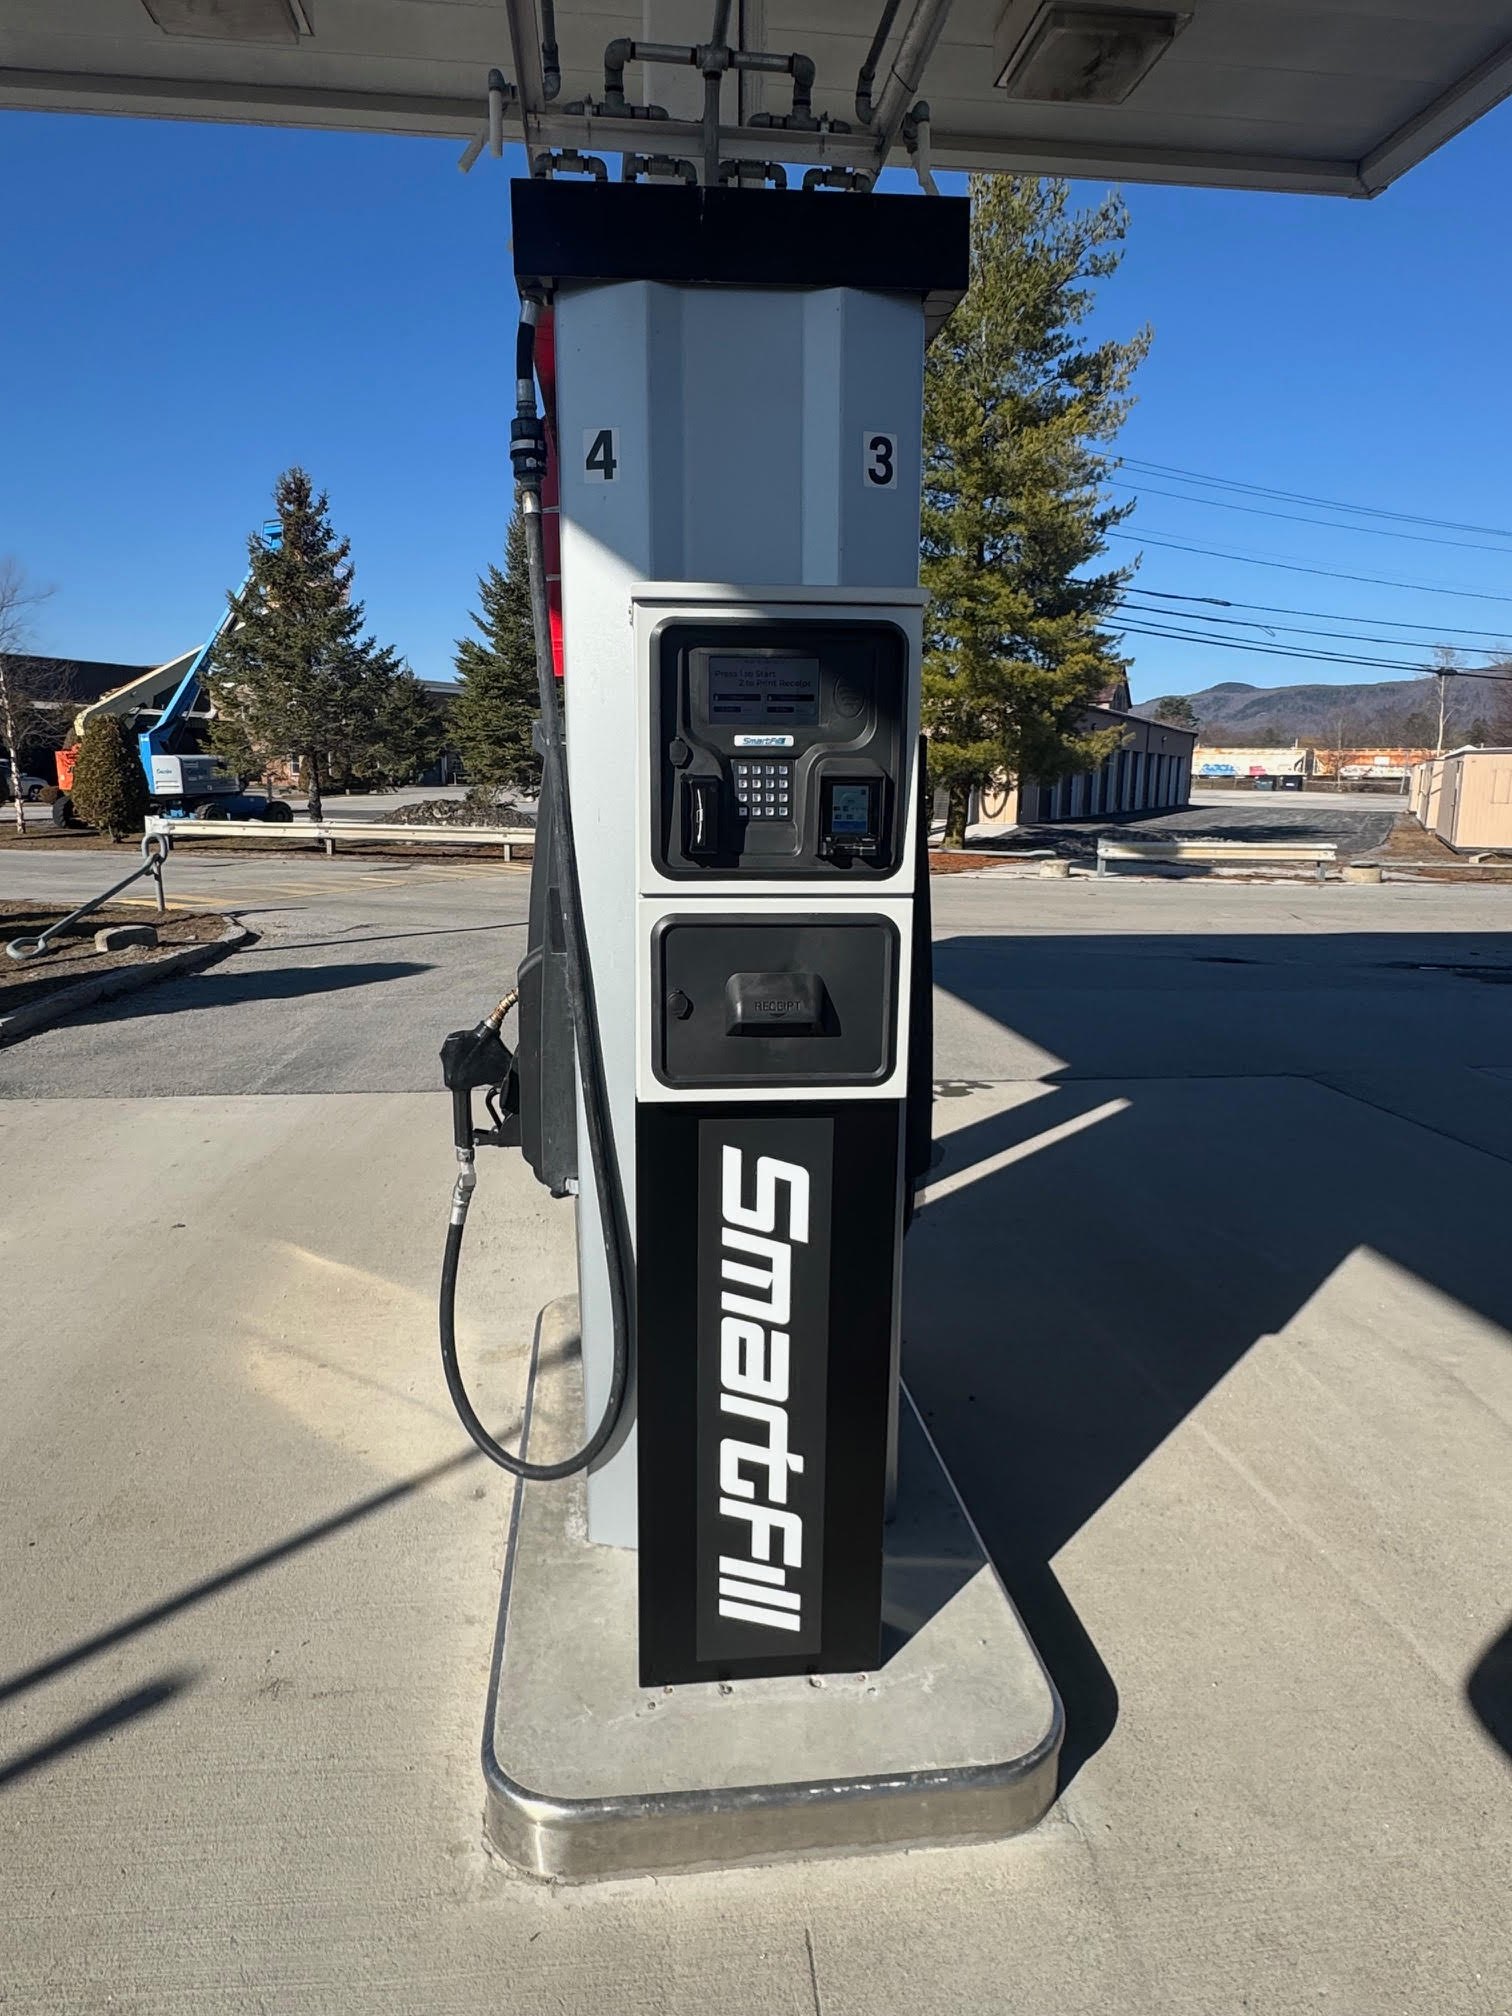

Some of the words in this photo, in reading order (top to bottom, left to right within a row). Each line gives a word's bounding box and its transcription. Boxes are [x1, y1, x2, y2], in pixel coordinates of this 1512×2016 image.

[585, 429, 617, 480] 4
[867, 435, 894, 485] 3
[714, 670, 738, 678] Press
[755, 669, 776, 678] Start
[738, 679, 745, 687] 2
[756, 679, 776, 687] Print
[779, 679, 811, 689] Receipt
[754, 1000, 802, 1012] RECEIPT
[718, 1144, 810, 1633] SmartFill
